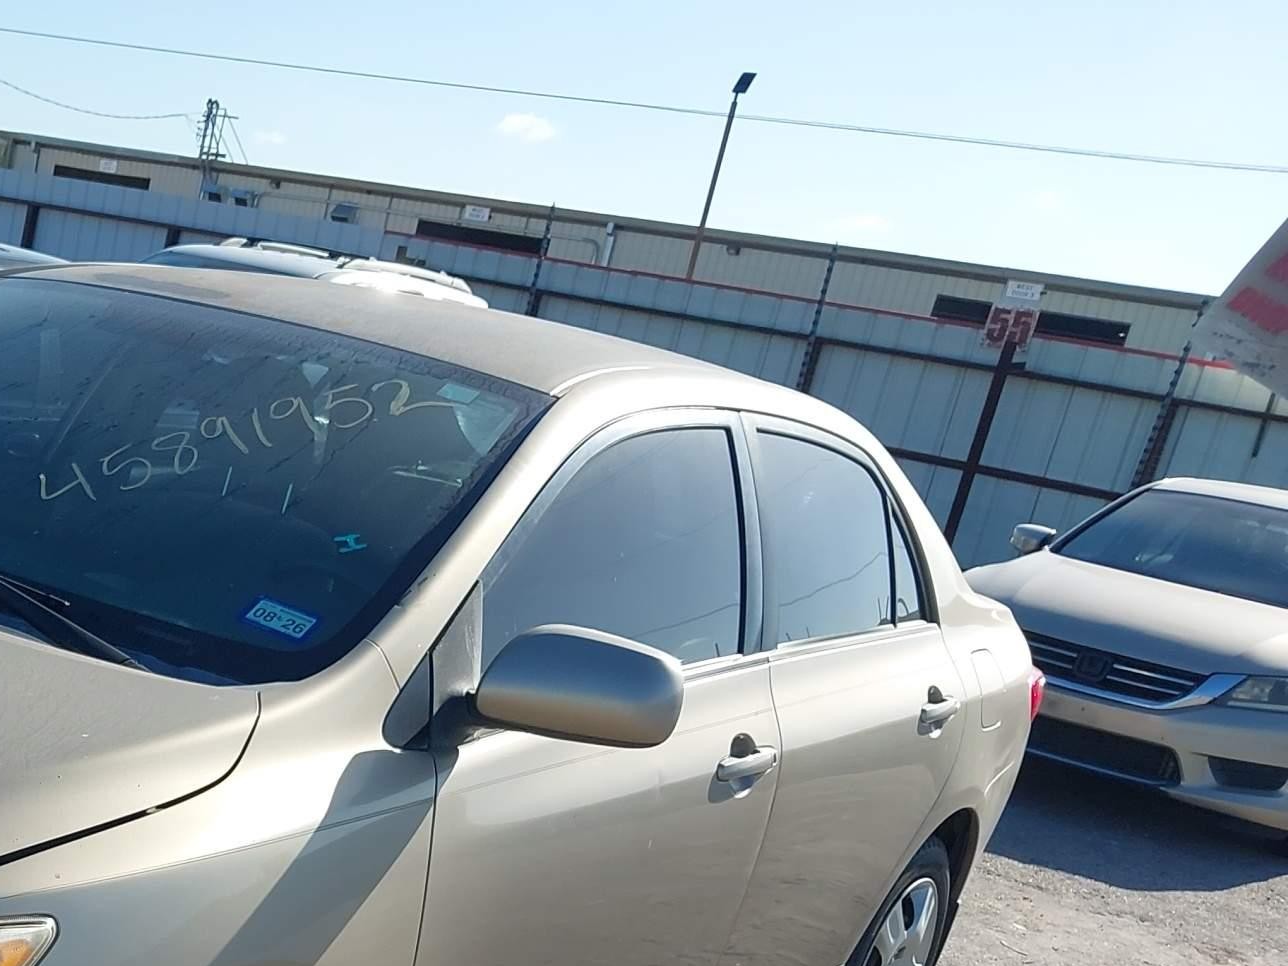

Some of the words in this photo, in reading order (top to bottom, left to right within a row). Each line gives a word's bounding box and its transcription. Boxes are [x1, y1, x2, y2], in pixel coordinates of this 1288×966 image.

[39, 379, 467, 500] 45891952
[253, 607, 277, 622] 08
[280, 619, 306, 633] 26
